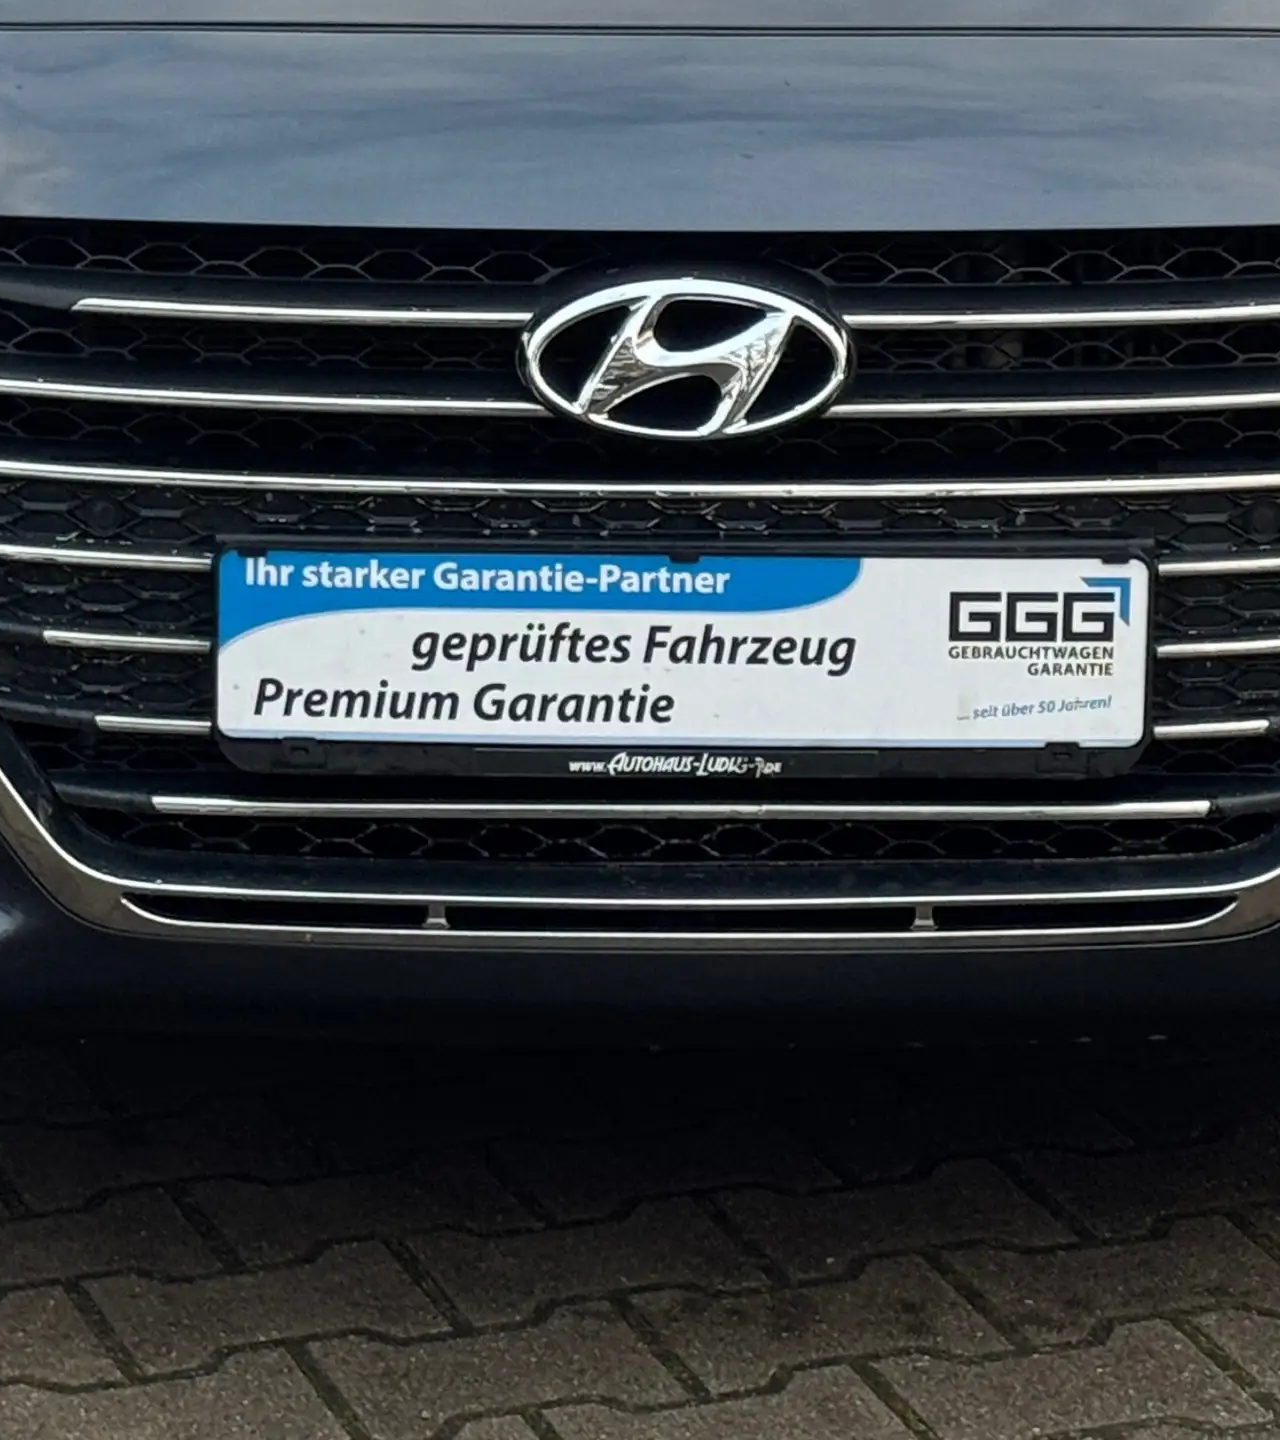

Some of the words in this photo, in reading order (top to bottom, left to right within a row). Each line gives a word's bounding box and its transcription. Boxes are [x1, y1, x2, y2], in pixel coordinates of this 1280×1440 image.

[245, 557, 295, 587] Ihr
[301, 559, 426, 589] starker
[433, 561, 731, 594] Garantie-Partner
[948, 591, 1116, 643] GGG
[411, 621, 632, 672] geprüftes
[642, 623, 857, 677] Fahrzeug
[947, 645, 1114, 660] GEBRAUCHTWAGEN
[1027, 662, 1113, 677] GARANTIE
[253, 677, 460, 721] Premium
[473, 682, 675, 724] Garantie
[1001, 702, 1035, 717] über
[1037, 700, 1056, 714] 50
